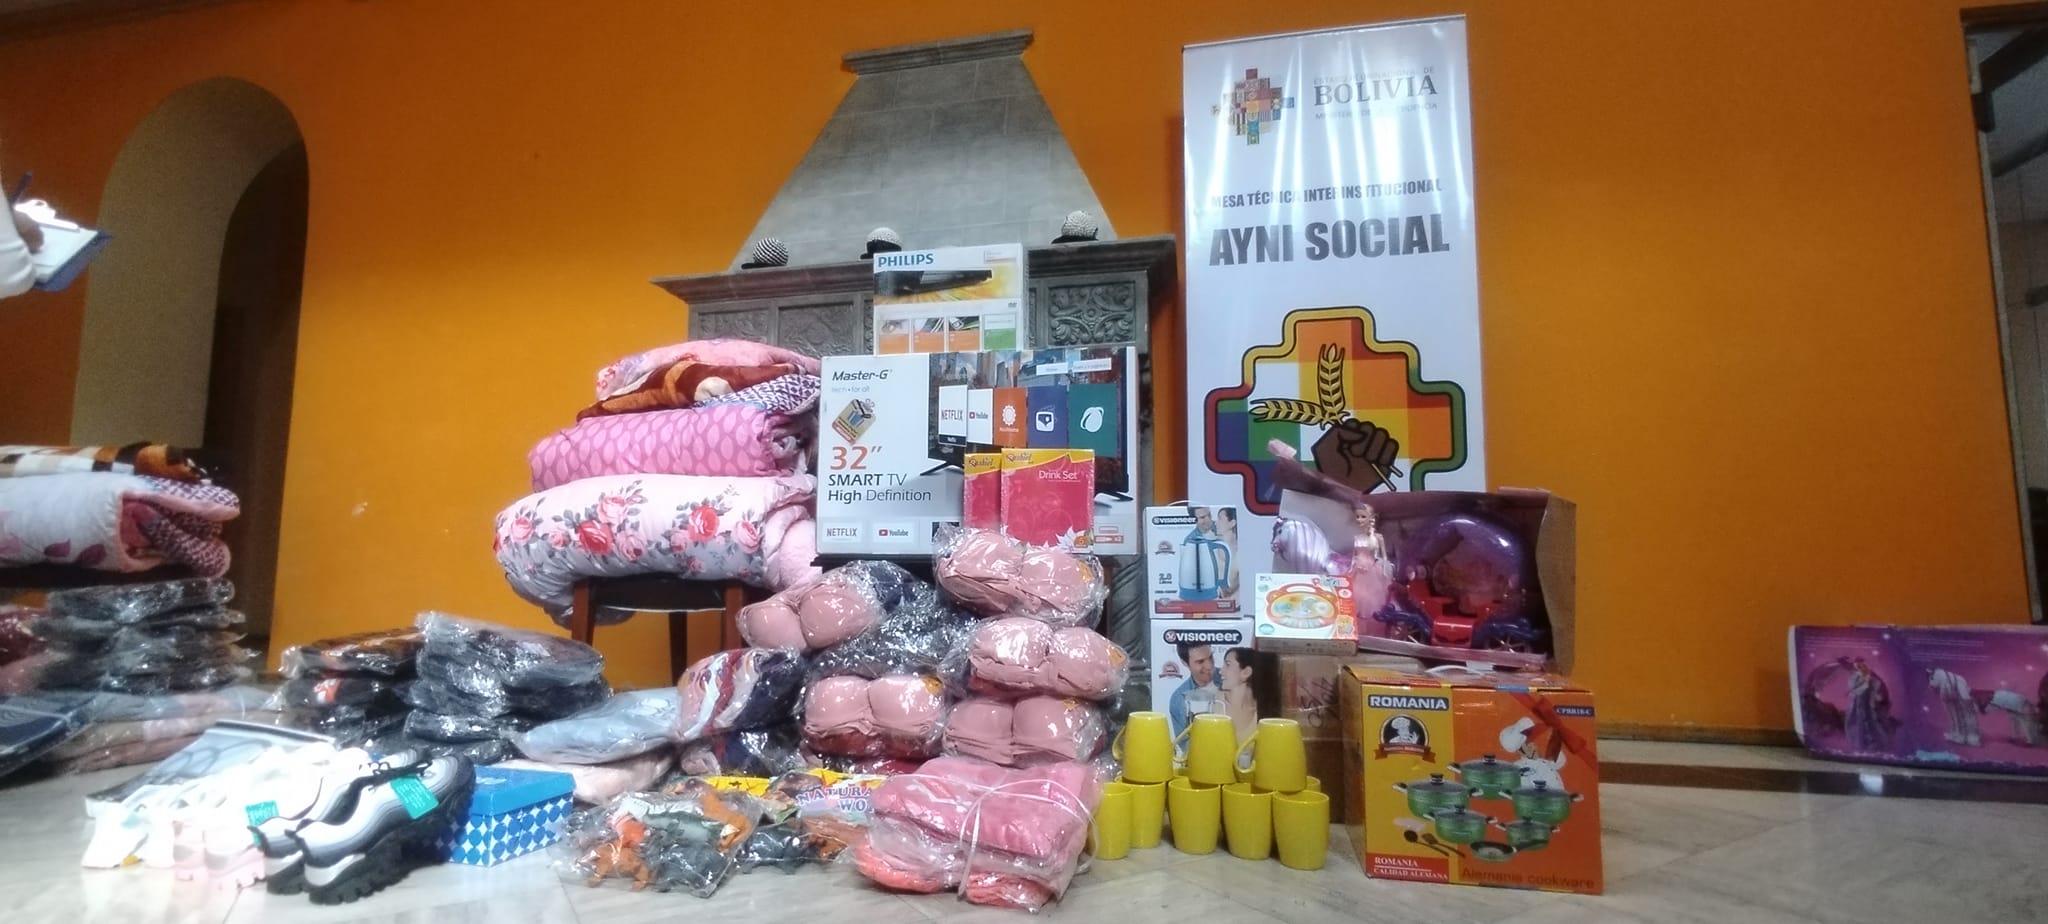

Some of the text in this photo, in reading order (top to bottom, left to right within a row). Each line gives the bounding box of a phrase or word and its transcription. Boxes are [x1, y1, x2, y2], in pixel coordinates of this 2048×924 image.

[1314, 74, 1438, 107] BOLIVIA
[1212, 192, 1245, 209] MESA
[1209, 213, 1450, 267] AYNI SOCIAL
[877, 252, 935, 268] PHILIPS
[831, 368, 889, 382] Master-G
[940, 409, 964, 422] NETFLIX
[828, 473, 908, 487] SMART TV
[1038, 469, 1078, 480] Drink Set
[828, 488, 932, 505] High Definition
[826, 527, 858, 538] NETFLIX
[1176, 631, 1240, 642] visioneer
[1370, 696, 1447, 709] ROMANIA
[1374, 856, 1419, 868] ROMANIA
[1373, 866, 1449, 881] CALIDAD ALEMANA
[1527, 872, 1595, 889] cookware
